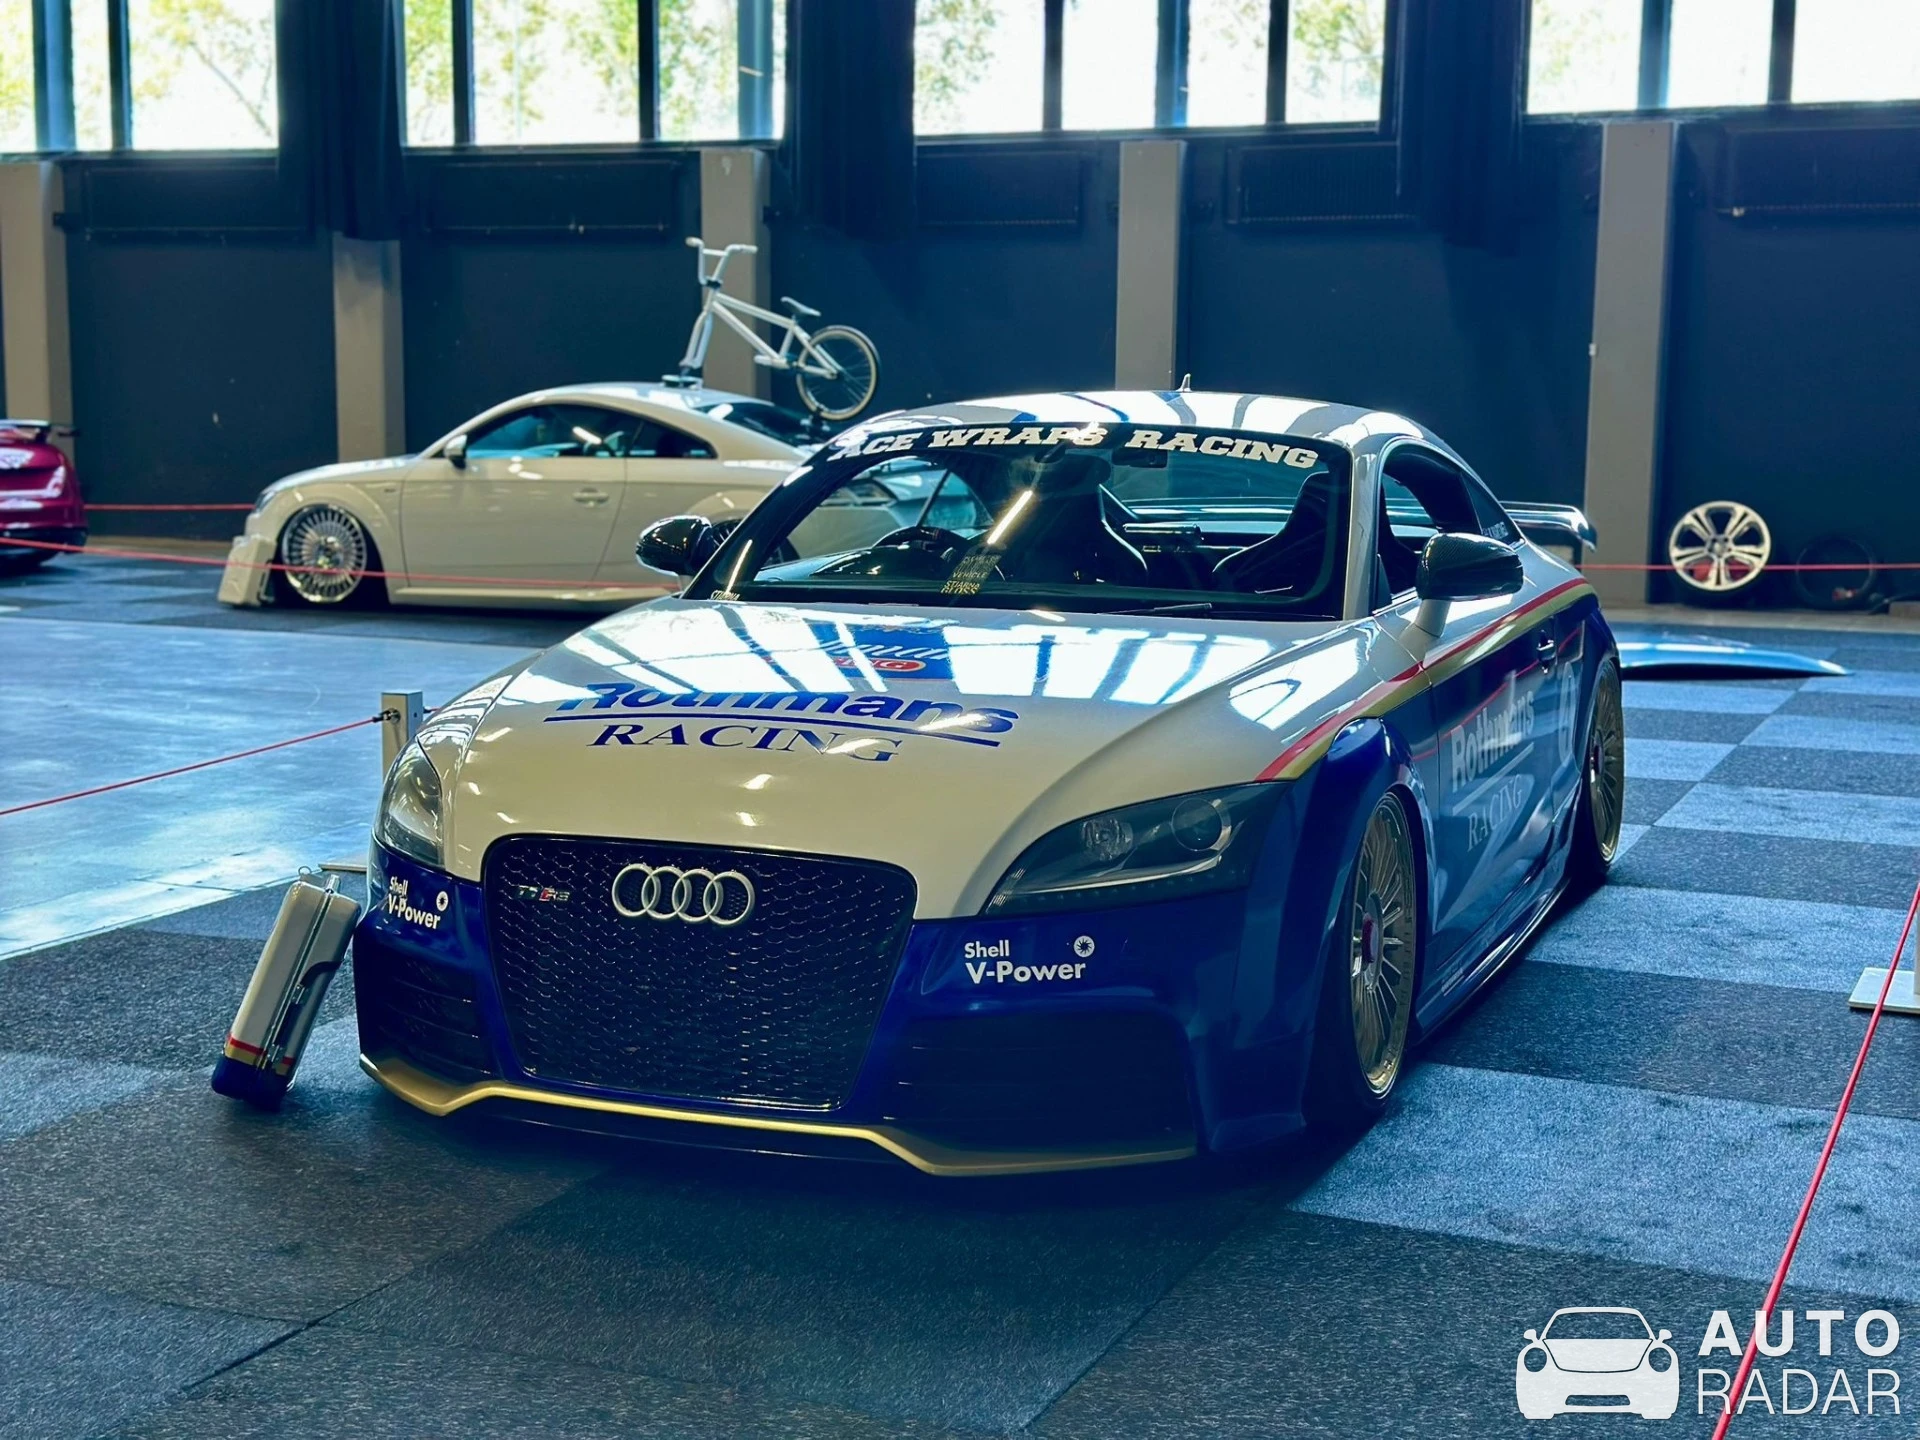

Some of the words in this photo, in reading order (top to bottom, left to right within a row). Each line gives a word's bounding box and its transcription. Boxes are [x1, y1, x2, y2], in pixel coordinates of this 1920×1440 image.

[928, 427, 1108, 448] WRAPS
[1125, 429, 1319, 469] RACING
[586, 723, 903, 762] RACING
[1451, 690, 1535, 793] Rothmans
[389, 876, 409, 896] Shell
[388, 892, 441, 930] V-Power
[964, 939, 1010, 959] Shell
[965, 960, 1086, 984] V-Power
